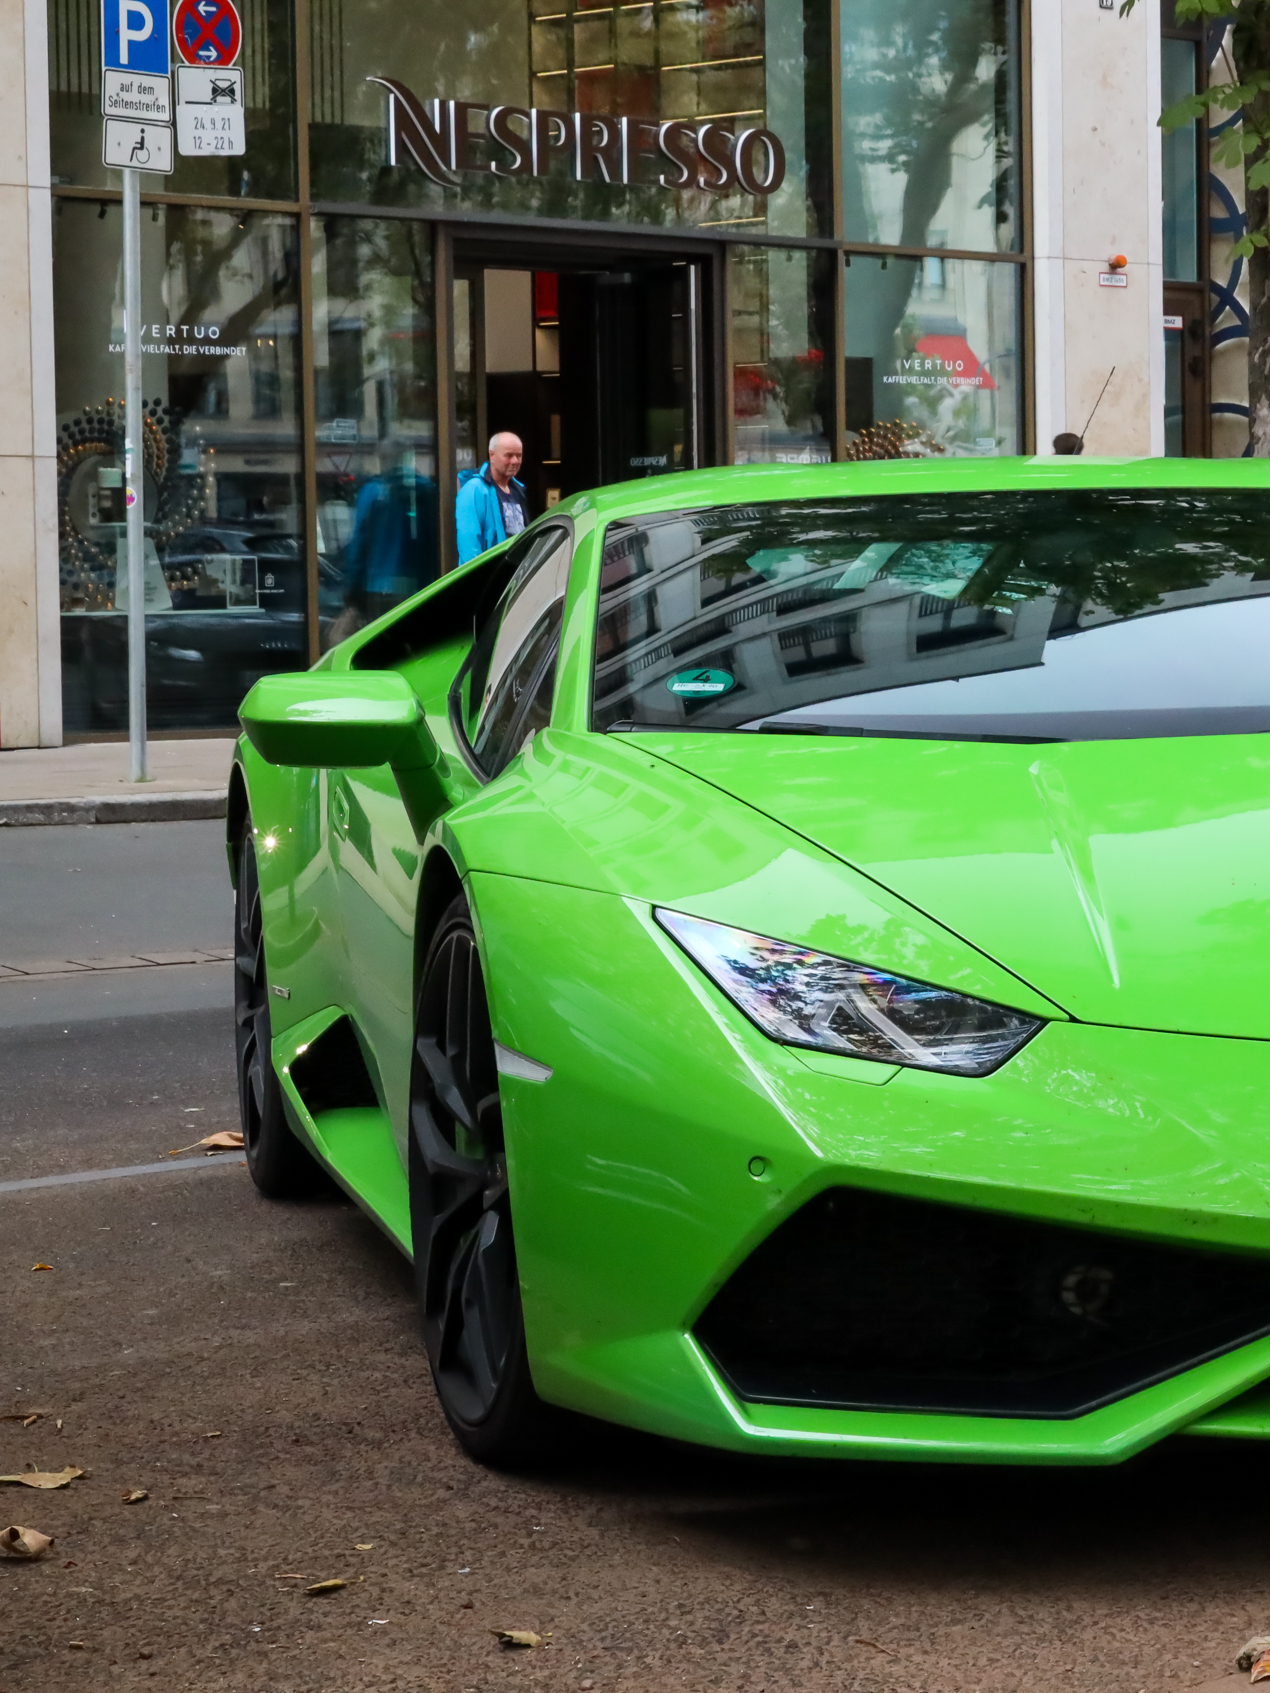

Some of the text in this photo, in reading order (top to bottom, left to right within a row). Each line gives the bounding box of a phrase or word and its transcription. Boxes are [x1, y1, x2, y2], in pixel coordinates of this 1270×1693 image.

[119, 0, 154, 65] P
[119, 81, 155, 95] auf dem
[108, 95, 167, 114] Seitenstreifen
[366, 76, 786, 195] NESPRESSO
[193, 137, 203, 150] 12
[214, 137, 226, 150] 22
[228, 137, 234, 150] h
[108, 343, 247, 357] KAFVIELFALT, DIE VERBINDET
[903, 359, 964, 371] VERTUO
[937, 376, 948, 385] DIE
[948, 376, 984, 386] VERBINDET
[692, 669, 712, 683] 4
